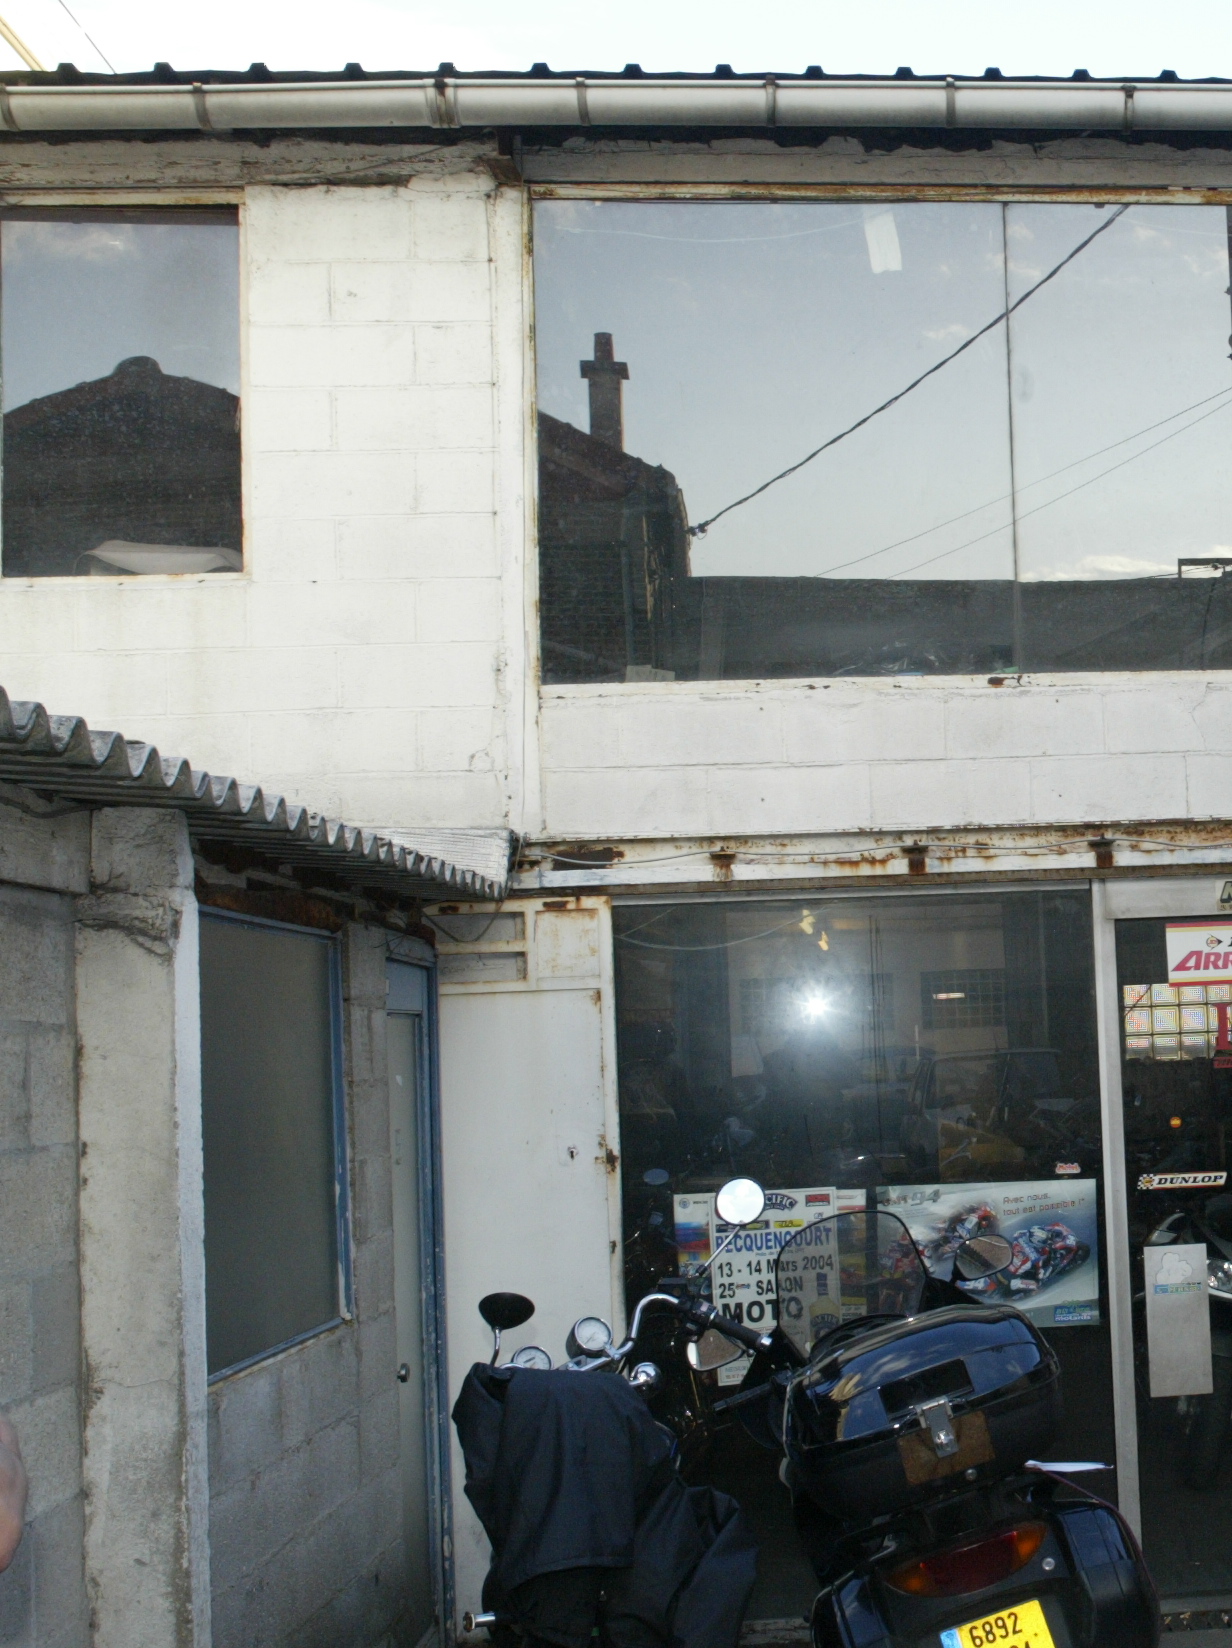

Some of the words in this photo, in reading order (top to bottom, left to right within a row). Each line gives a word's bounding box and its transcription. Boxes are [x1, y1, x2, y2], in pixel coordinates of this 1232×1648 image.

[1156, 1174, 1224, 1186] DUNLOP
[1003, 1208, 1020, 1216] tout
[1023, 1205, 1036, 1213] est
[1039, 1200, 1075, 1211] possible
[717, 1262, 733, 1278] 13
[747, 1260, 762, 1276] 14
[767, 1259, 798, 1274] Mars
[802, 1254, 834, 1272] 2004
[721, 1296, 804, 1325] MOTO
[968, 1612, 1023, 1648] 6892
